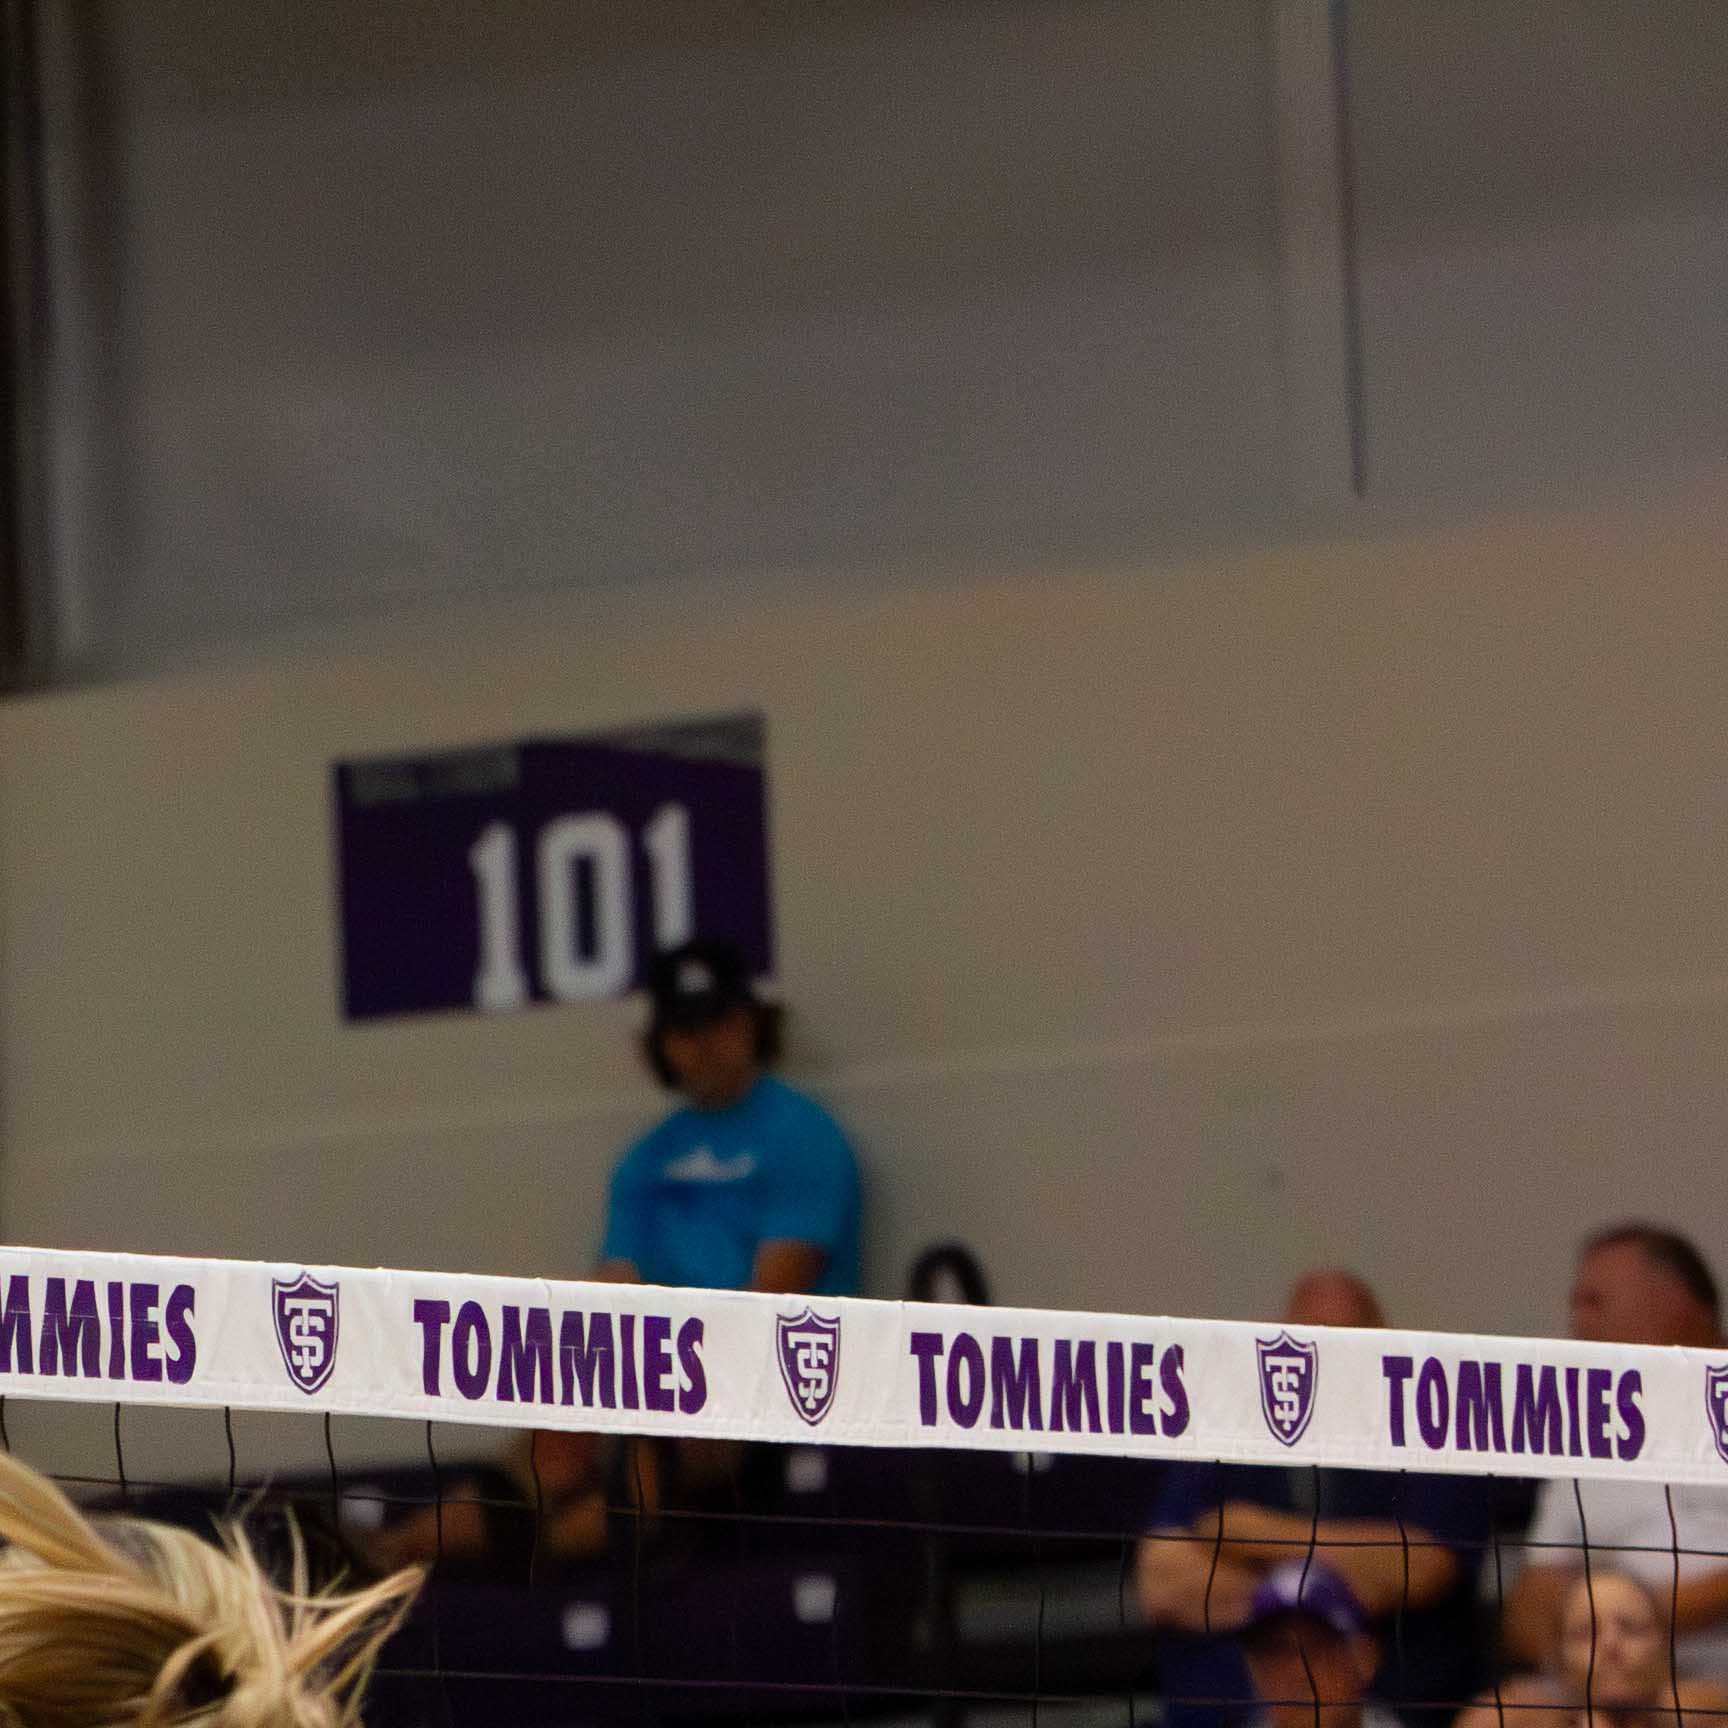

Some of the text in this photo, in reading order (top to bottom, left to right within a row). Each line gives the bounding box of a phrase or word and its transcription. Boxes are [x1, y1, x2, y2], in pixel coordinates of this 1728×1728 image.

[469, 800, 696, 1010] 101
[413, 1299, 707, 1415] TOMMIES
[910, 1331, 1191, 1438] TOMMIES
[1382, 1355, 1645, 1462] TOMMIES
